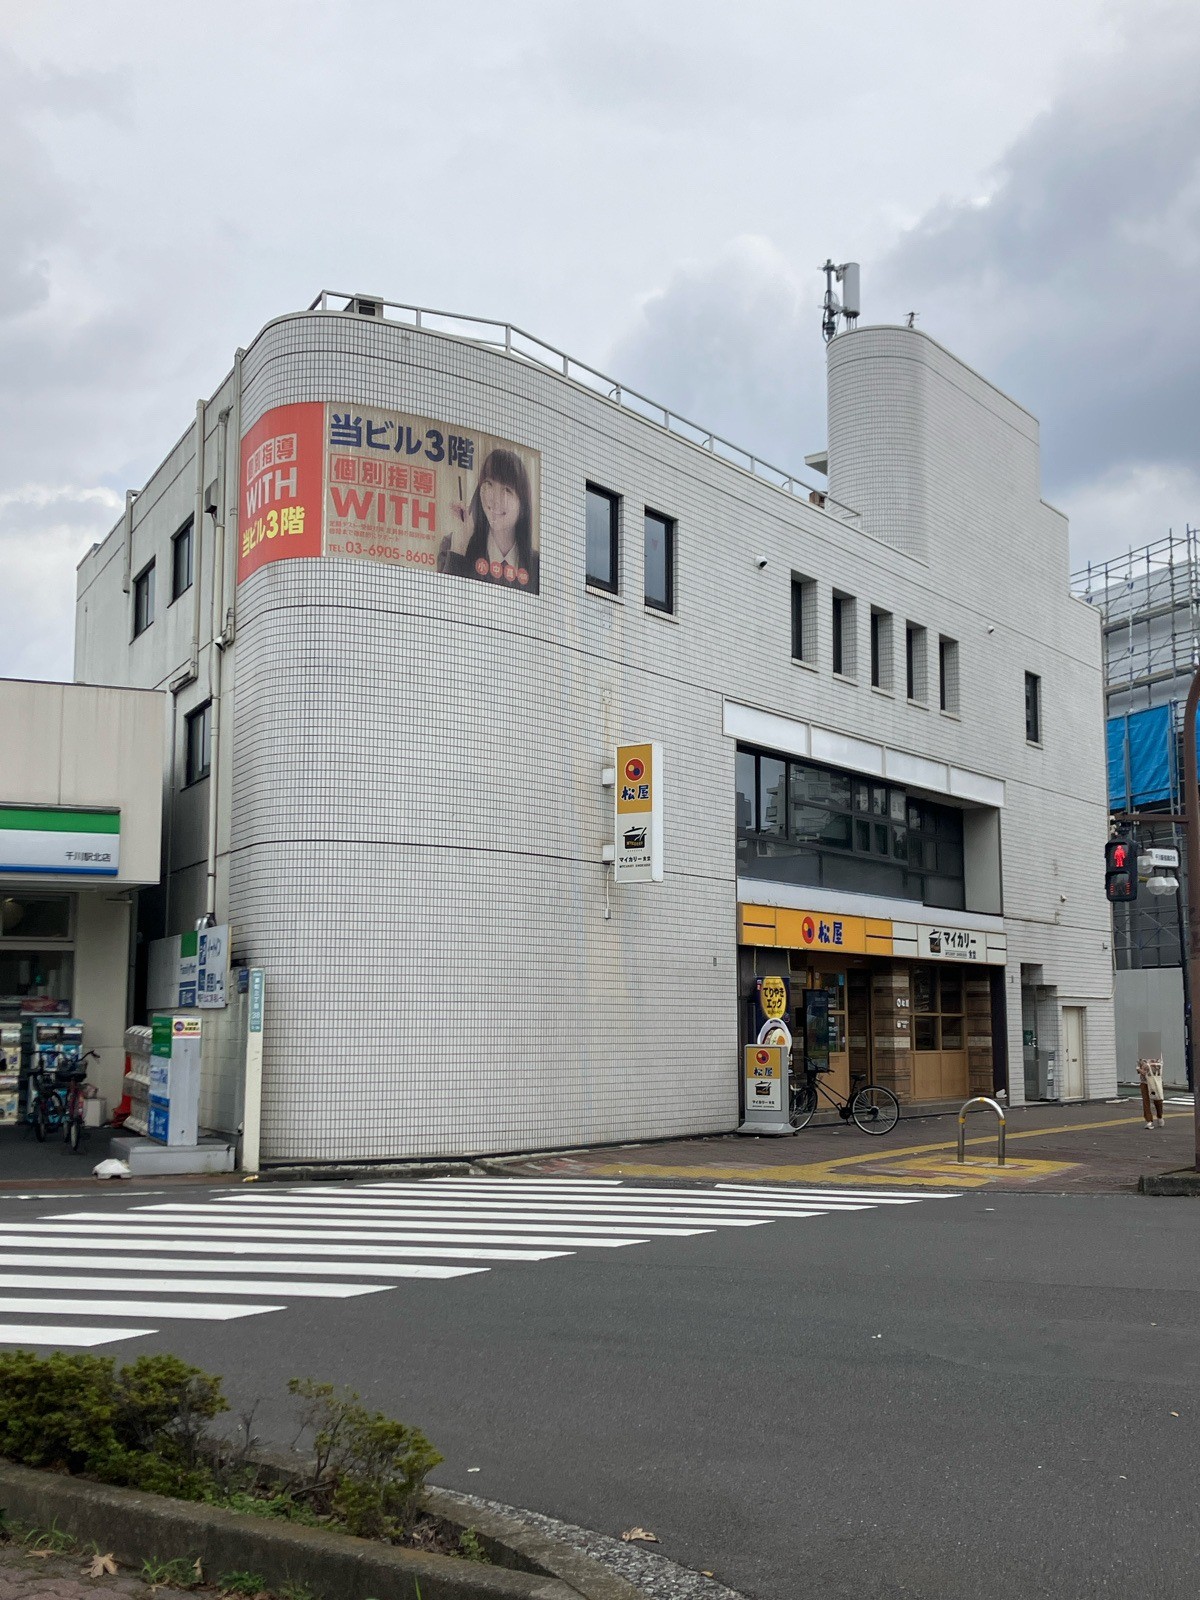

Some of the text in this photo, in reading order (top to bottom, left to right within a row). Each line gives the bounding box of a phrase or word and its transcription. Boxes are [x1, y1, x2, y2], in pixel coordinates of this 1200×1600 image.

[330, 413, 475, 471] 当ビル3階
[332, 456, 435, 496] 個別指導
[246, 467, 298, 518] WITH
[330, 487, 436, 532] WITH
[242, 506, 305, 558] 当ビル3階
[345, 541, 436, 566] 03-6905-8605
[621, 784, 650, 801] 松屋
[817, 920, 843, 945] 松屋
[943, 931, 977, 949] マイカリー
[763, 987, 785, 998] てりやき
[766, 998, 783, 1009] エッグ
